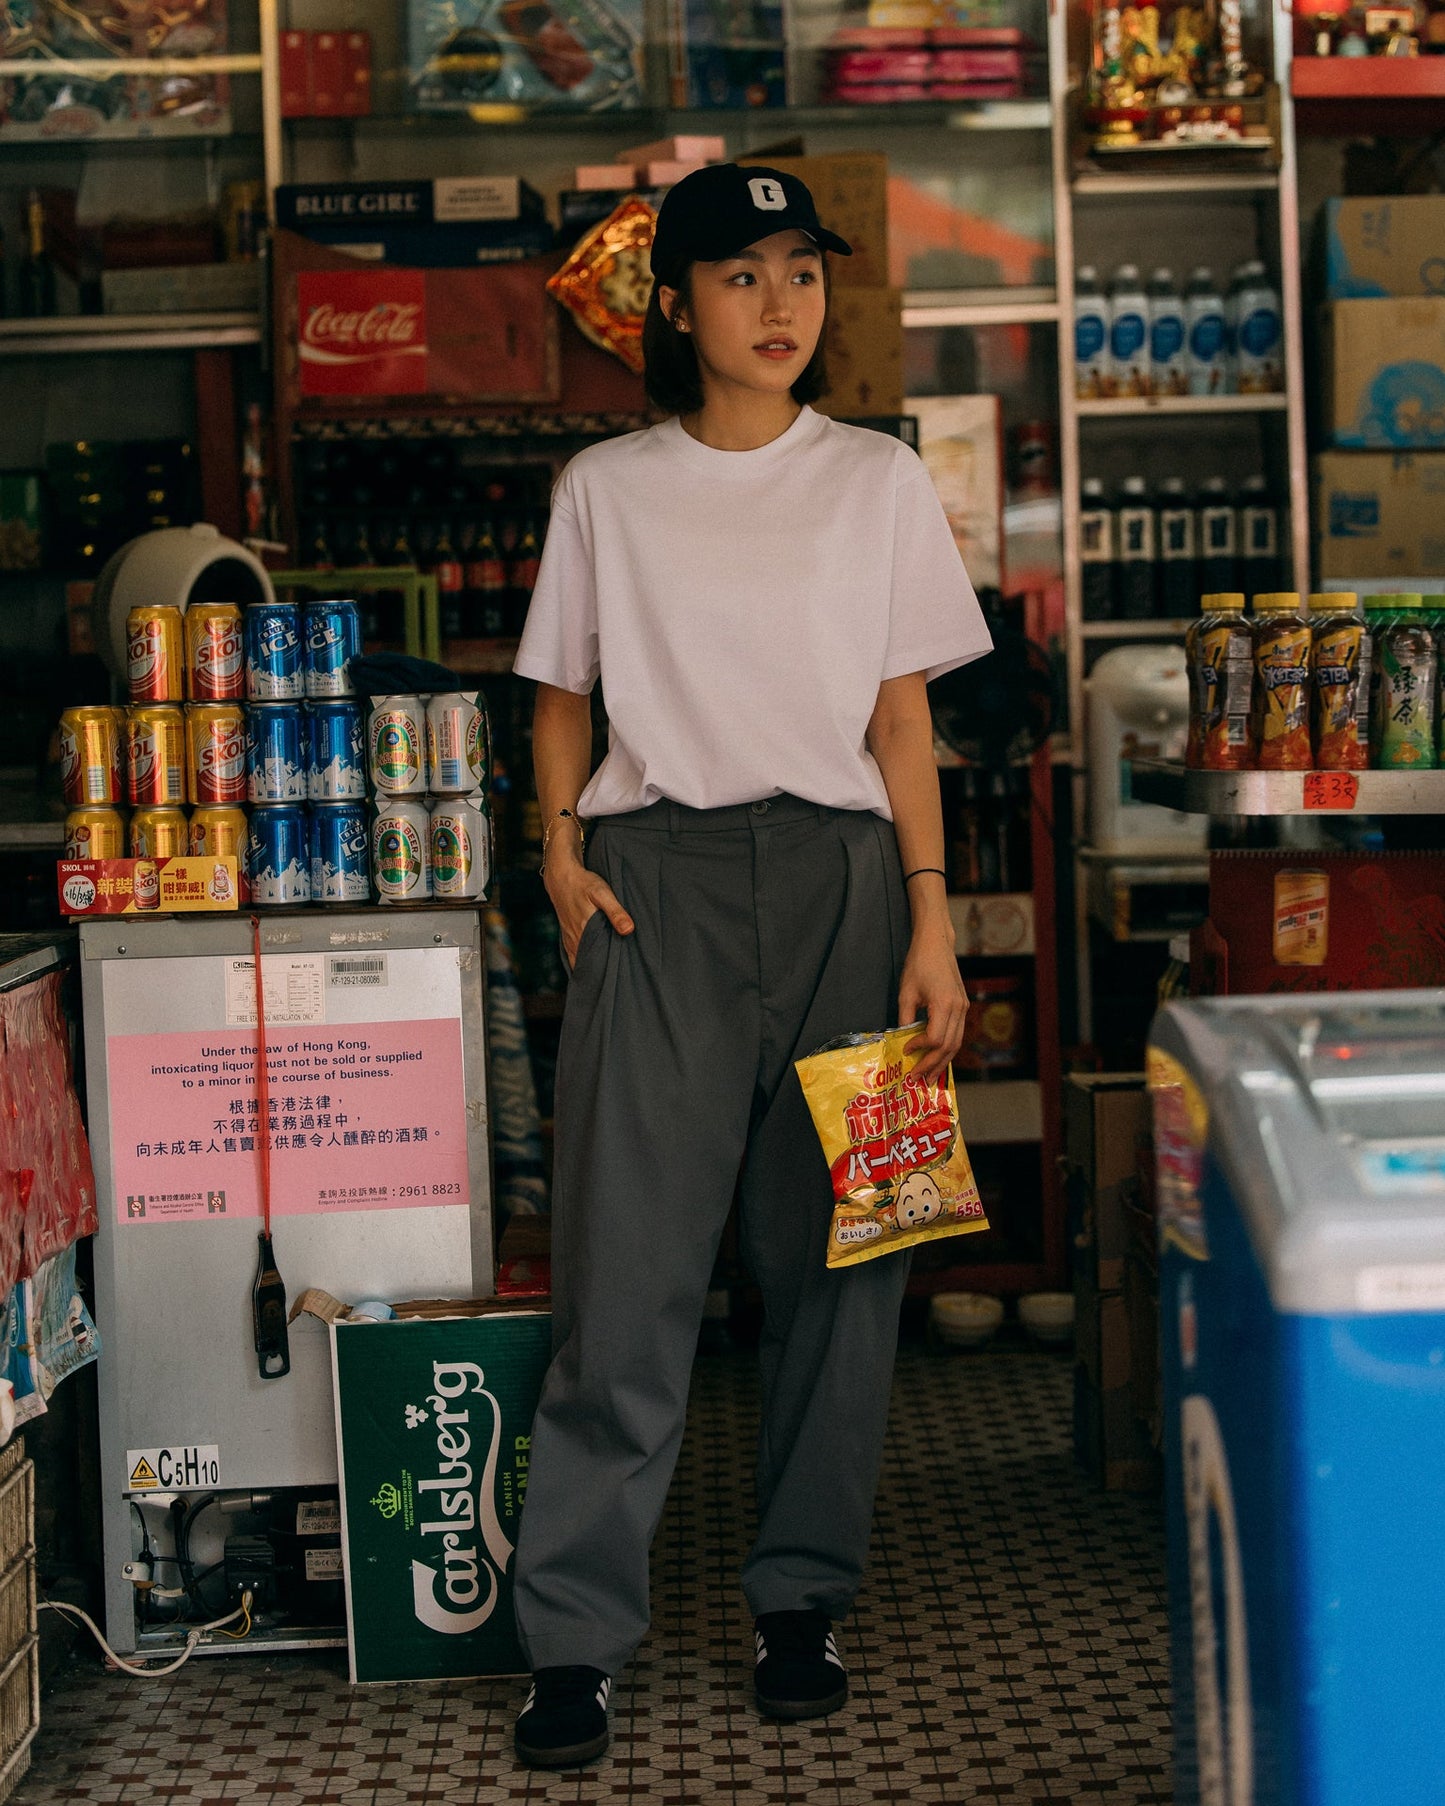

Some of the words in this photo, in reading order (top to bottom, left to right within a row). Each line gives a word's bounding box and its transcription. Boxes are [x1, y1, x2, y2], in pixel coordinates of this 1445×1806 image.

[296, 194, 356, 216] BLUE
[358, 192, 419, 213] GIRL
[747, 178, 788, 210] G
[260, 630, 298, 657] ICE
[262, 625, 286, 638] BLUE
[127, 639, 155, 661] KOL
[198, 637, 242, 664] SKOL
[403, 721, 418, 747] BEER
[202, 739, 245, 766] SKOL
[403, 827, 419, 853] BEER
[61, 864, 82, 872] SKOL
[162, 868, 188, 880] 一樣
[97, 877, 134, 896] 新裝
[236, 1015, 249, 1023] FREE
[202, 1047, 236, 1058] Under
[240, 1045, 258, 1055] the
[265, 1046, 282, 1054] aw
[287, 1042, 299, 1053] of
[303, 1041, 334, 1054] Hong
[337, 1039, 371, 1051] Kong,
[151, 1062, 219, 1075] intoxicating
[222, 1060, 255, 1073] liquor
[291, 1057, 311, 1068] not
[314, 1056, 329, 1066] be
[332, 1054, 356, 1065] sold
[359, 1054, 371, 1063] or
[375, 1051, 423, 1066] supplied
[182, 1079, 193, 1088] to
[198, 1079, 205, 1087] a
[209, 1076, 241, 1087] minor
[245, 1074, 256, 1084] in
[267, 1073, 278, 1083] he
[282, 1072, 320, 1083] course
[324, 1070, 336, 1080] of
[340, 1068, 394, 1079] business.
[847, 1128, 952, 1182] バーベキュー
[432, 1183, 461, 1195] 8823
[956, 1200, 982, 1217] 55g
[412, 1360, 514, 1634] Carlsberg
[503, 1471, 514, 1516] DANISH
